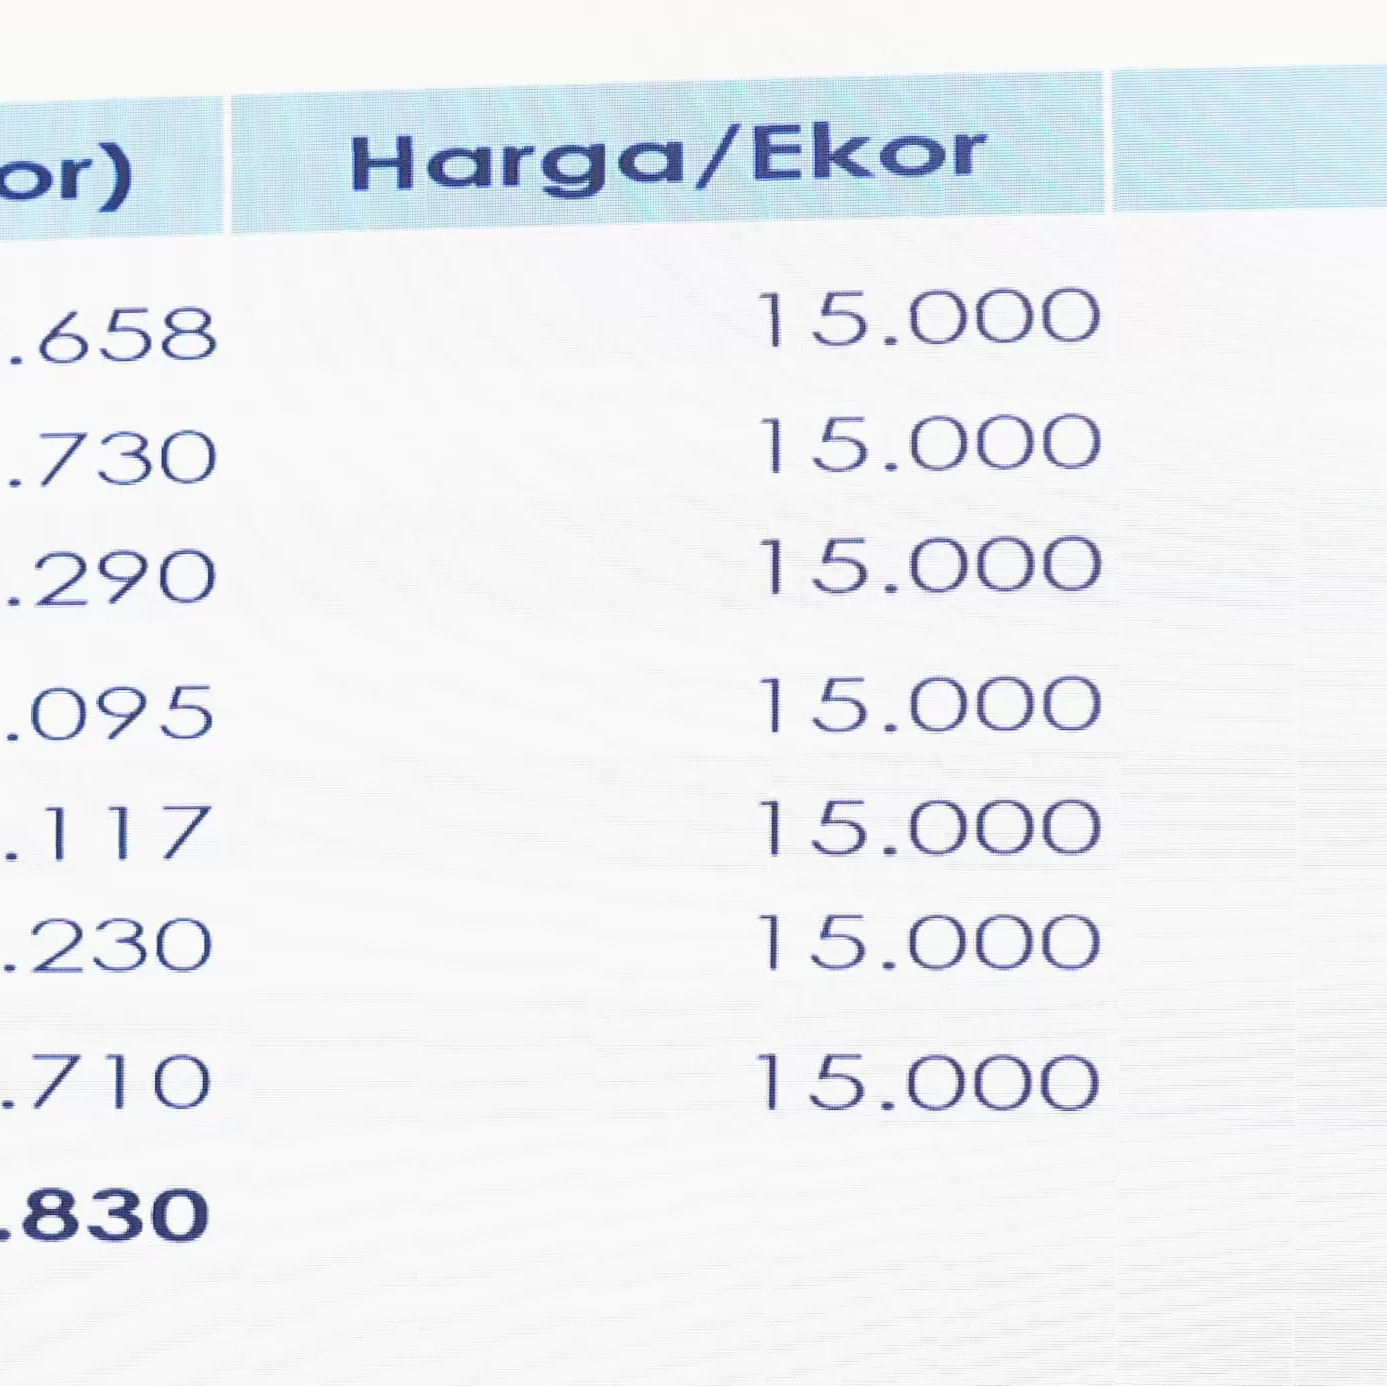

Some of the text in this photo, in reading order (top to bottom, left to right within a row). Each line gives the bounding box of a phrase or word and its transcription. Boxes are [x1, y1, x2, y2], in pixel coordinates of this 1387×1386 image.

[351, 121, 987, 200] Harga/Ekor
[761, 289, 1100, 346] 15.000
[762, 414, 1100, 473] 15.000
[761, 535, 1101, 594] 15.000
[761, 676, 1101, 732] 15.000
[761, 800, 1101, 857] 15.000
[760, 914, 1100, 971] 15.000
[758, 1054, 1099, 1111] 15.000
